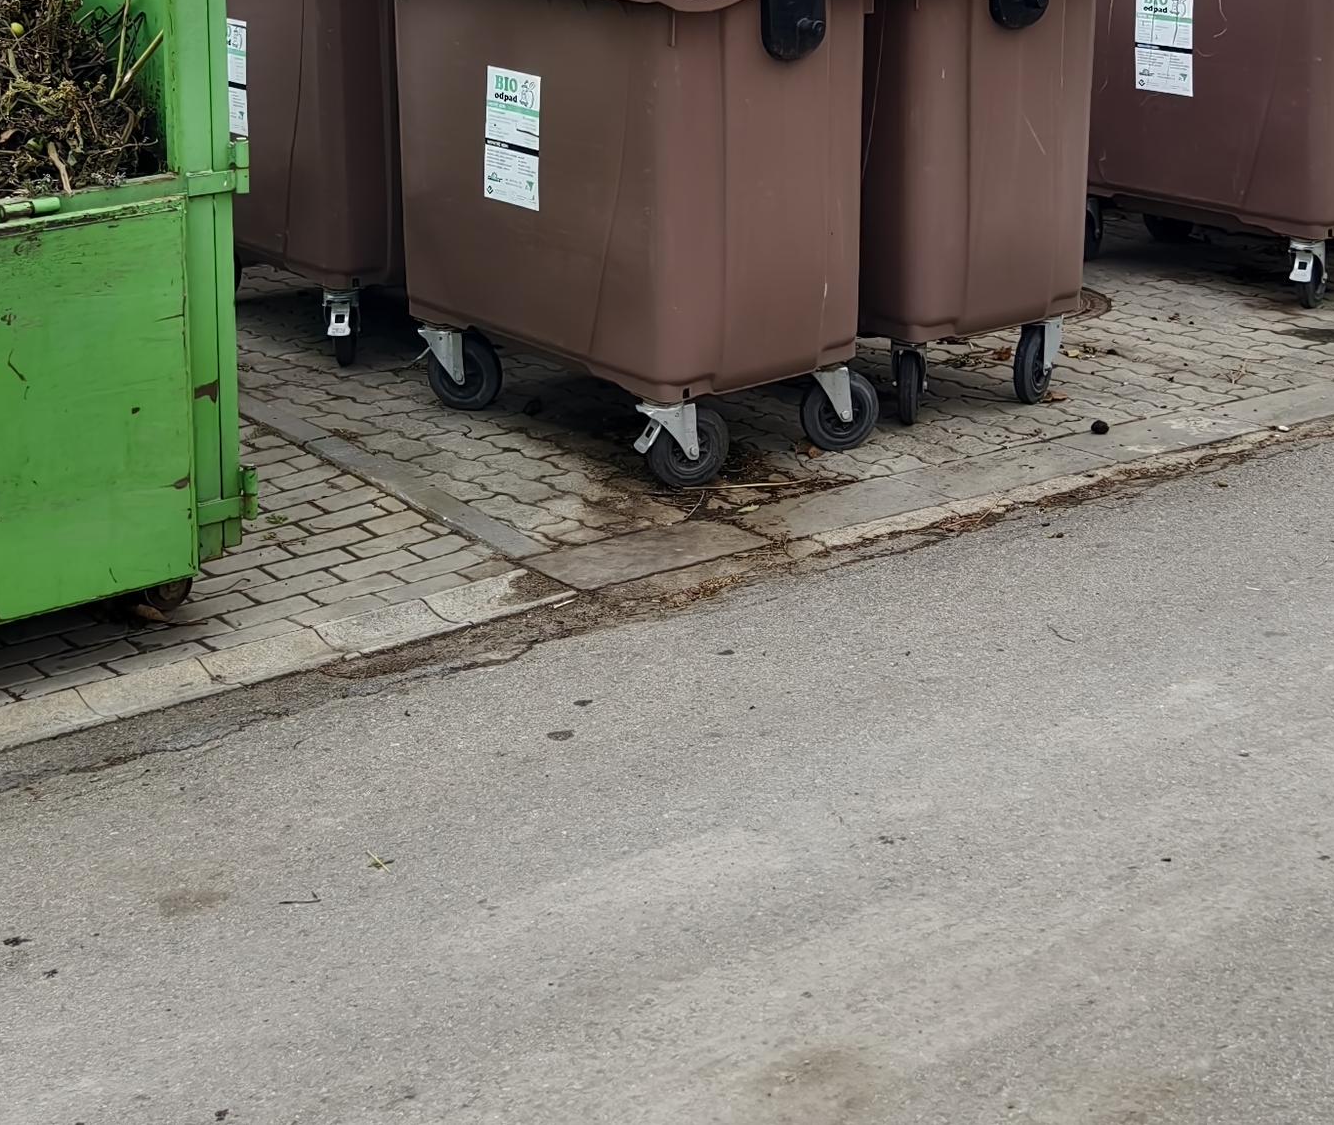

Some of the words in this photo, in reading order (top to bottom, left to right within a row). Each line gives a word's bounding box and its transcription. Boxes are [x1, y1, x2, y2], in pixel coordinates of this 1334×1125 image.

[1143, 5, 1168, 14] odpad
[494, 74, 518, 93] BIO
[494, 91, 518, 103] odpad
